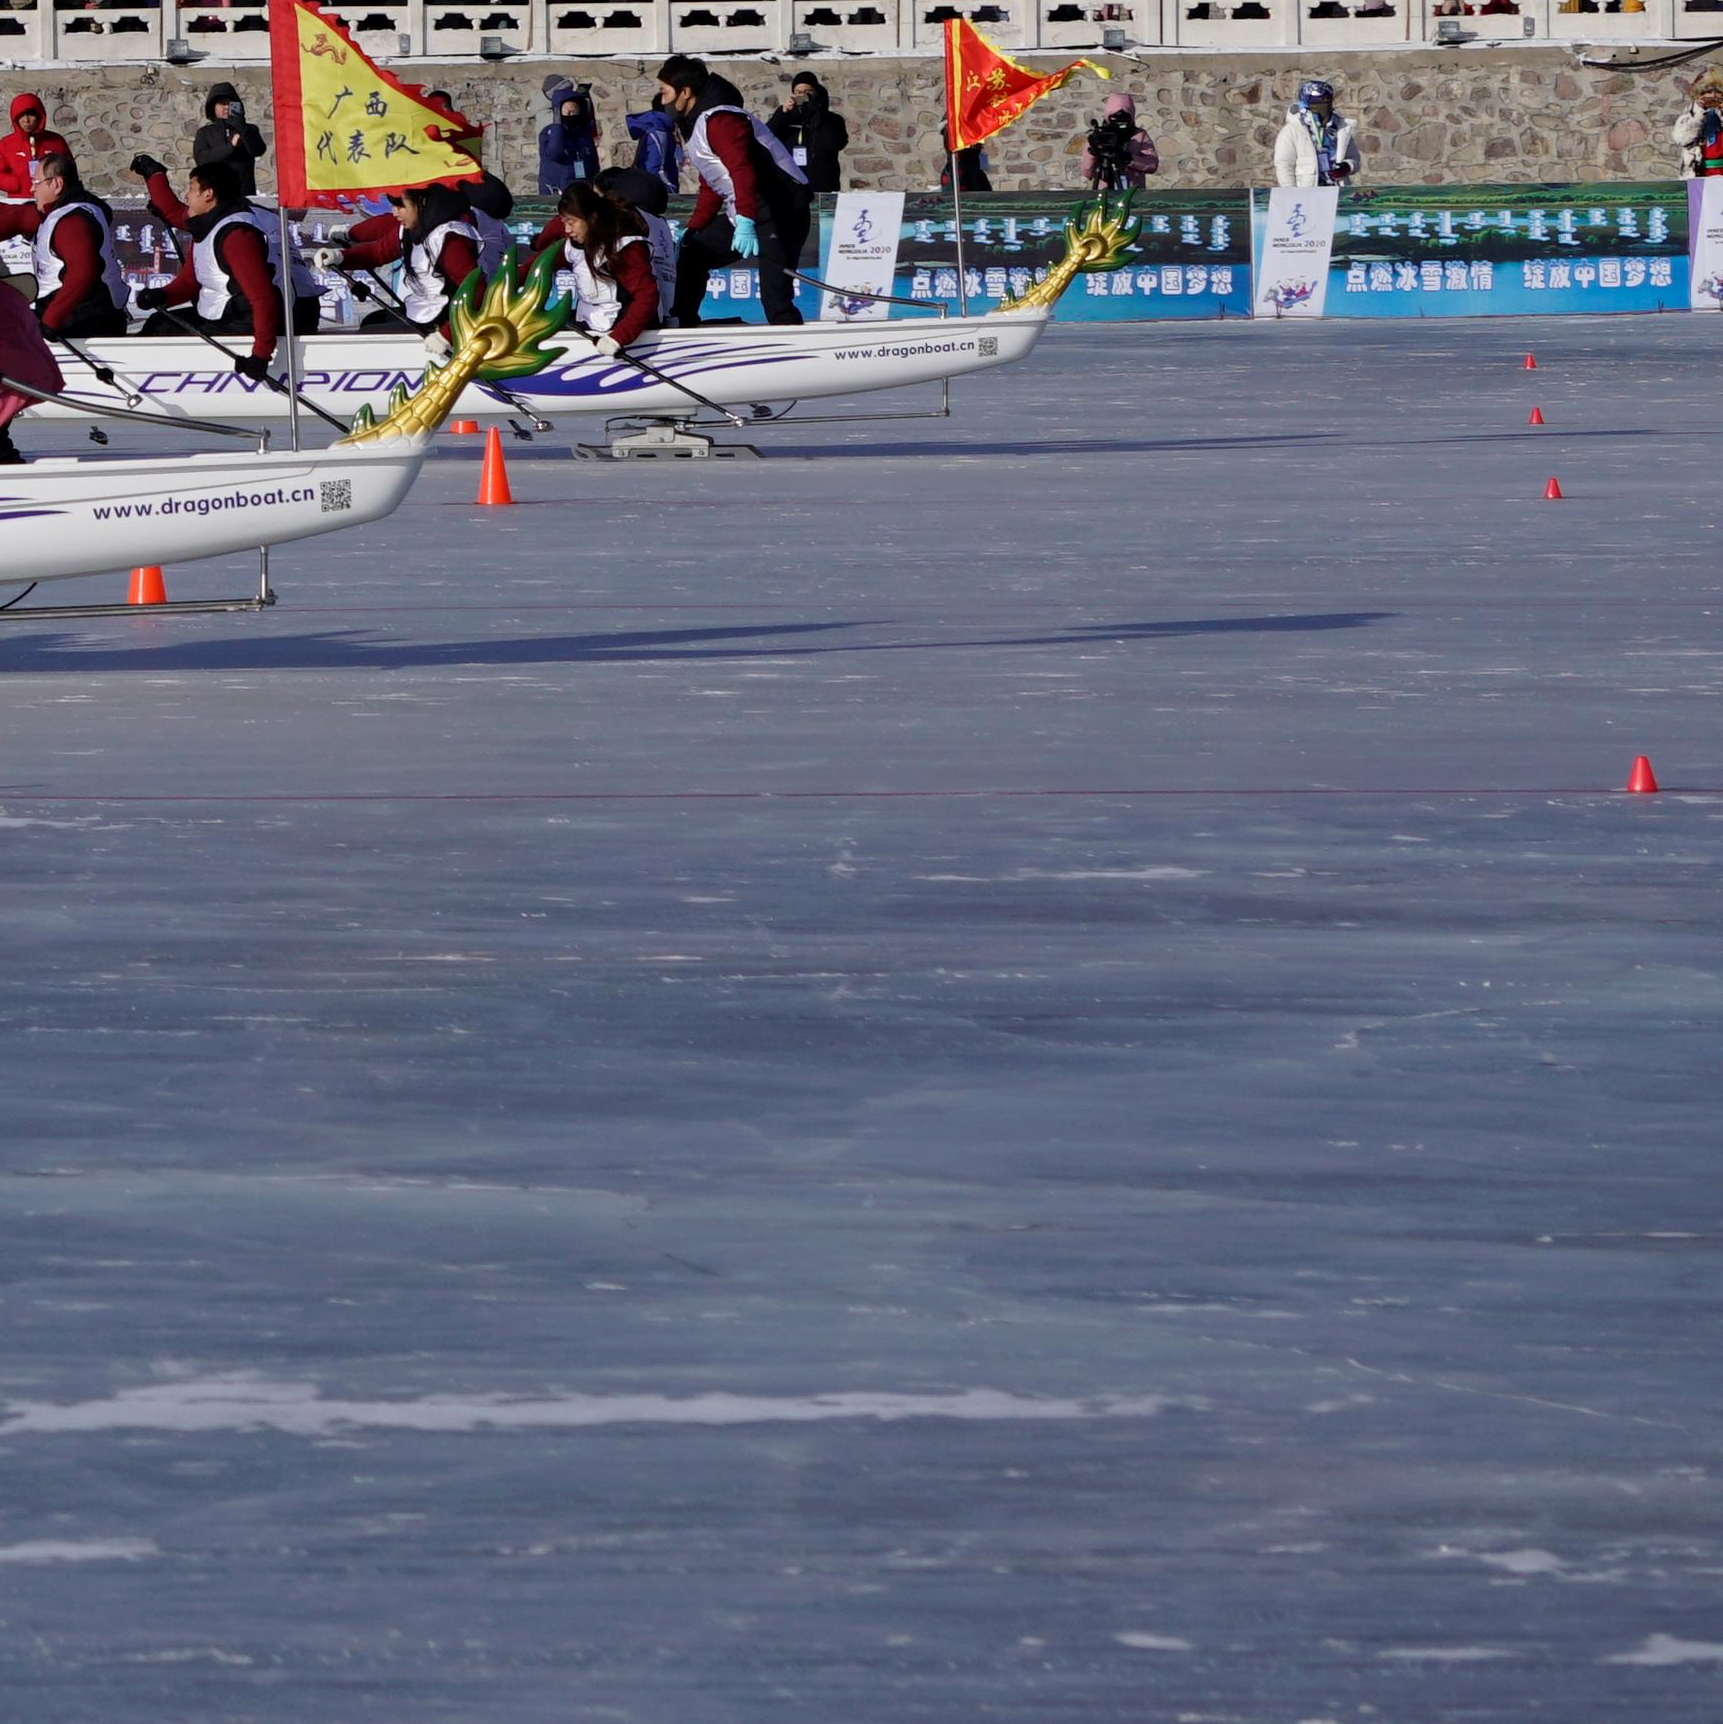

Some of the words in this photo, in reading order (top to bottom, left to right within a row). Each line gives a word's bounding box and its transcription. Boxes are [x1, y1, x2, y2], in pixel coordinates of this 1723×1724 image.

[327, 85, 389, 120] 广西
[316, 128, 421, 166] 代表队
[870, 246, 892, 254] 2020
[1304, 240, 1327, 248] 2020
[1085, 264, 1234, 297] 绽放中国梦想
[1345, 258, 1494, 292] 点燃冰雪激情
[1522, 256, 1672, 290] 绽放中国梦想
[834, 341, 976, 361] www.dragonboat.cn
[93, 488, 316, 522] www.dragonboat.cn
